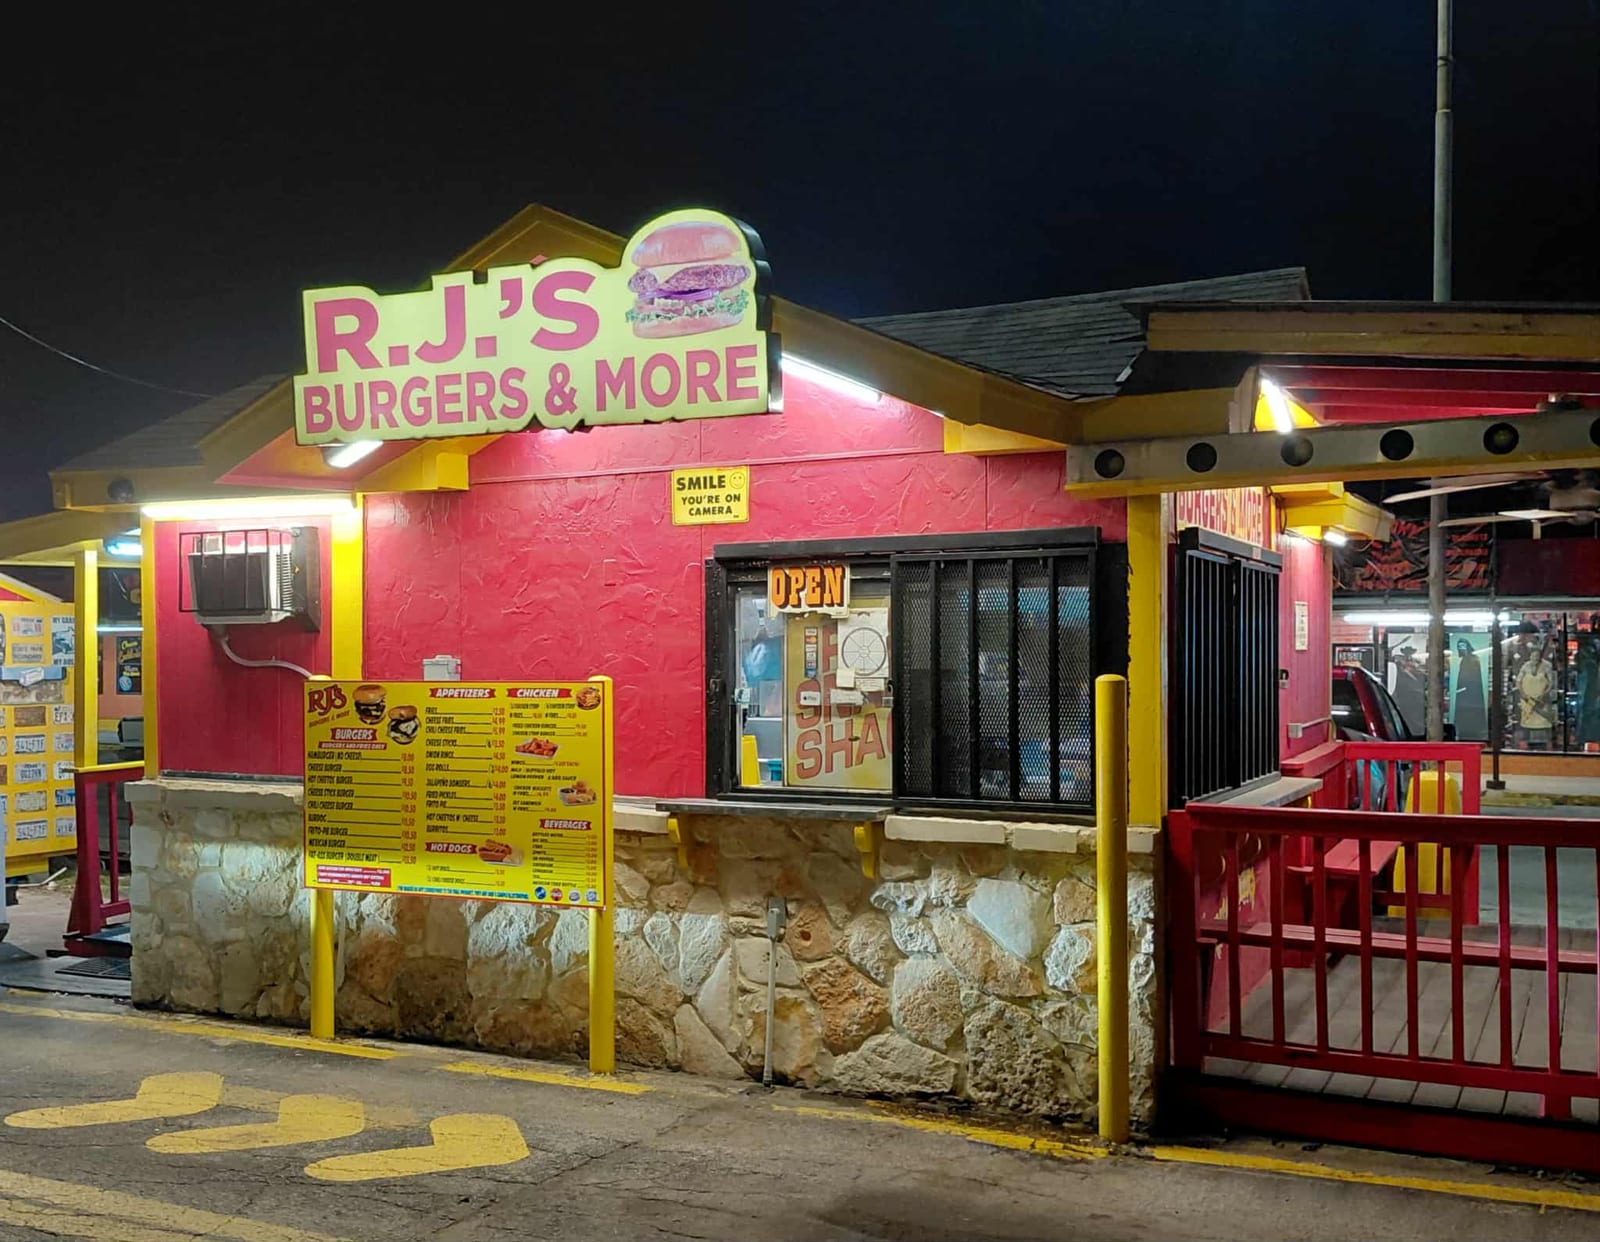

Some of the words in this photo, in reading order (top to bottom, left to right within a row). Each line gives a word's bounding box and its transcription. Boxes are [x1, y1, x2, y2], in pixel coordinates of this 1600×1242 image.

[314, 270, 600, 373] R.J.'S
[303, 367, 529, 434] BURGERS
[545, 362, 577, 416] &
[595, 343, 760, 412] MORE
[676, 475, 726, 491] SMILE
[681, 494, 720, 505] YOU'RE
[725, 493, 741, 503] ON
[688, 505, 732, 516] CAMERA
[1178, 489, 1228, 534] BURGERS
[1240, 488, 1261, 545] MORE
[772, 565, 846, 609] OPEN
[436, 688, 490, 697] APPETIZERS
[516, 689, 559, 697] CHICKEN
[335, 729, 373, 740] BURGERS
[437, 726, 453, 734] CHEESE
[308, 763, 324, 771] CHEESE
[324, 764, 342, 772] BURGER
[308, 788, 323, 796] CHEESE
[337, 789, 354, 798] BURGER
[319, 801, 335, 809] CHEESE
[336, 802, 353, 810] BURGER
[543, 820, 588, 829] BEVERAGES
[330, 827, 348, 836] BURGER
[328, 839, 346, 848] BURGER
[430, 843, 448, 851] HOT
[448, 844, 472, 852] DOGS
